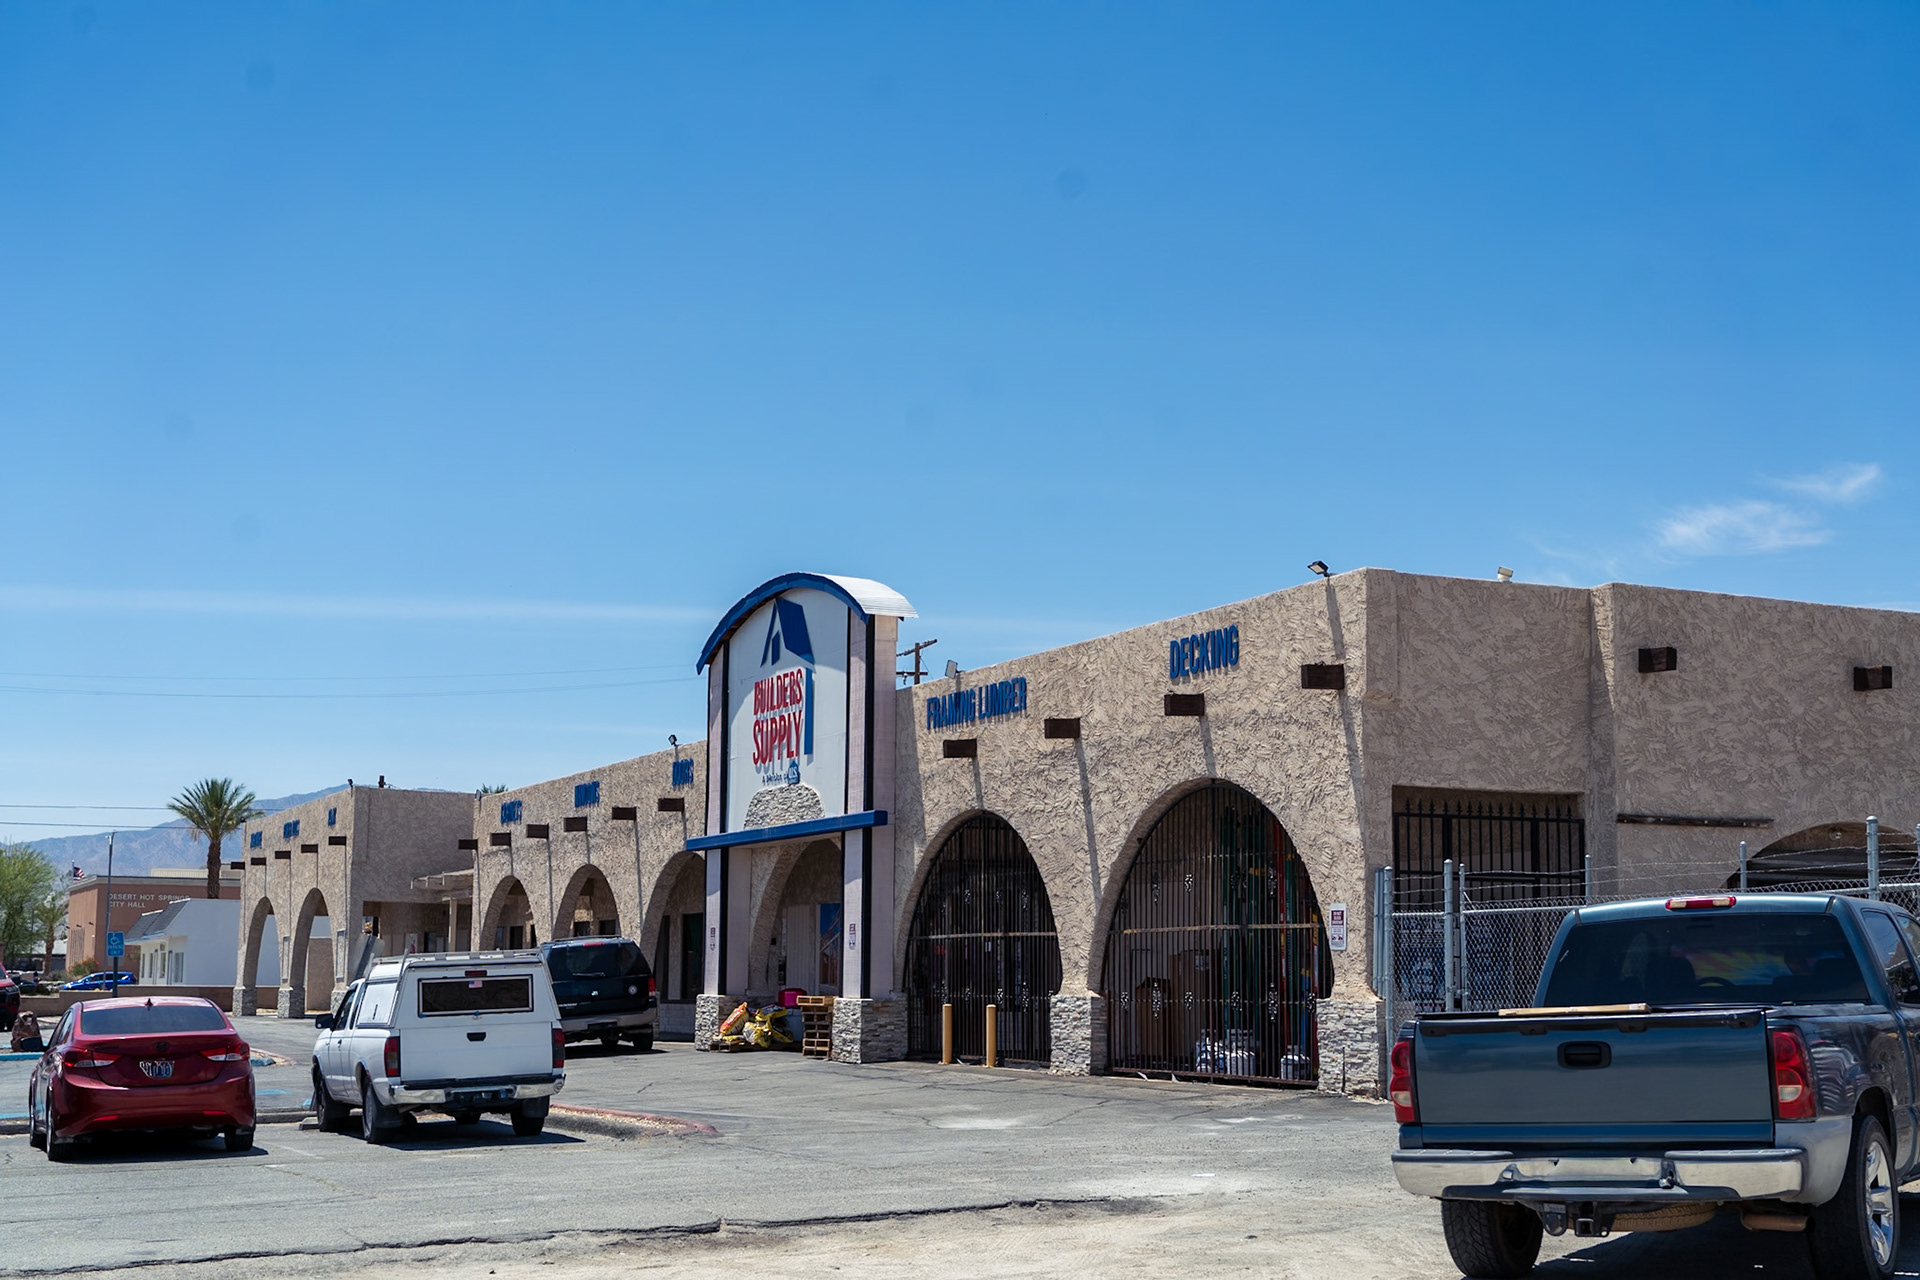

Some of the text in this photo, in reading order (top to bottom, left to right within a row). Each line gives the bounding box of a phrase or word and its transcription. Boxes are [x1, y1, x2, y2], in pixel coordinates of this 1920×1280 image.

[1169, 624, 1240, 679] DECKING
[753, 668, 803, 716] BUILDERS
[926, 676, 1027, 731] FRAMING LUMBER
[752, 709, 803, 766] SUPPLY
